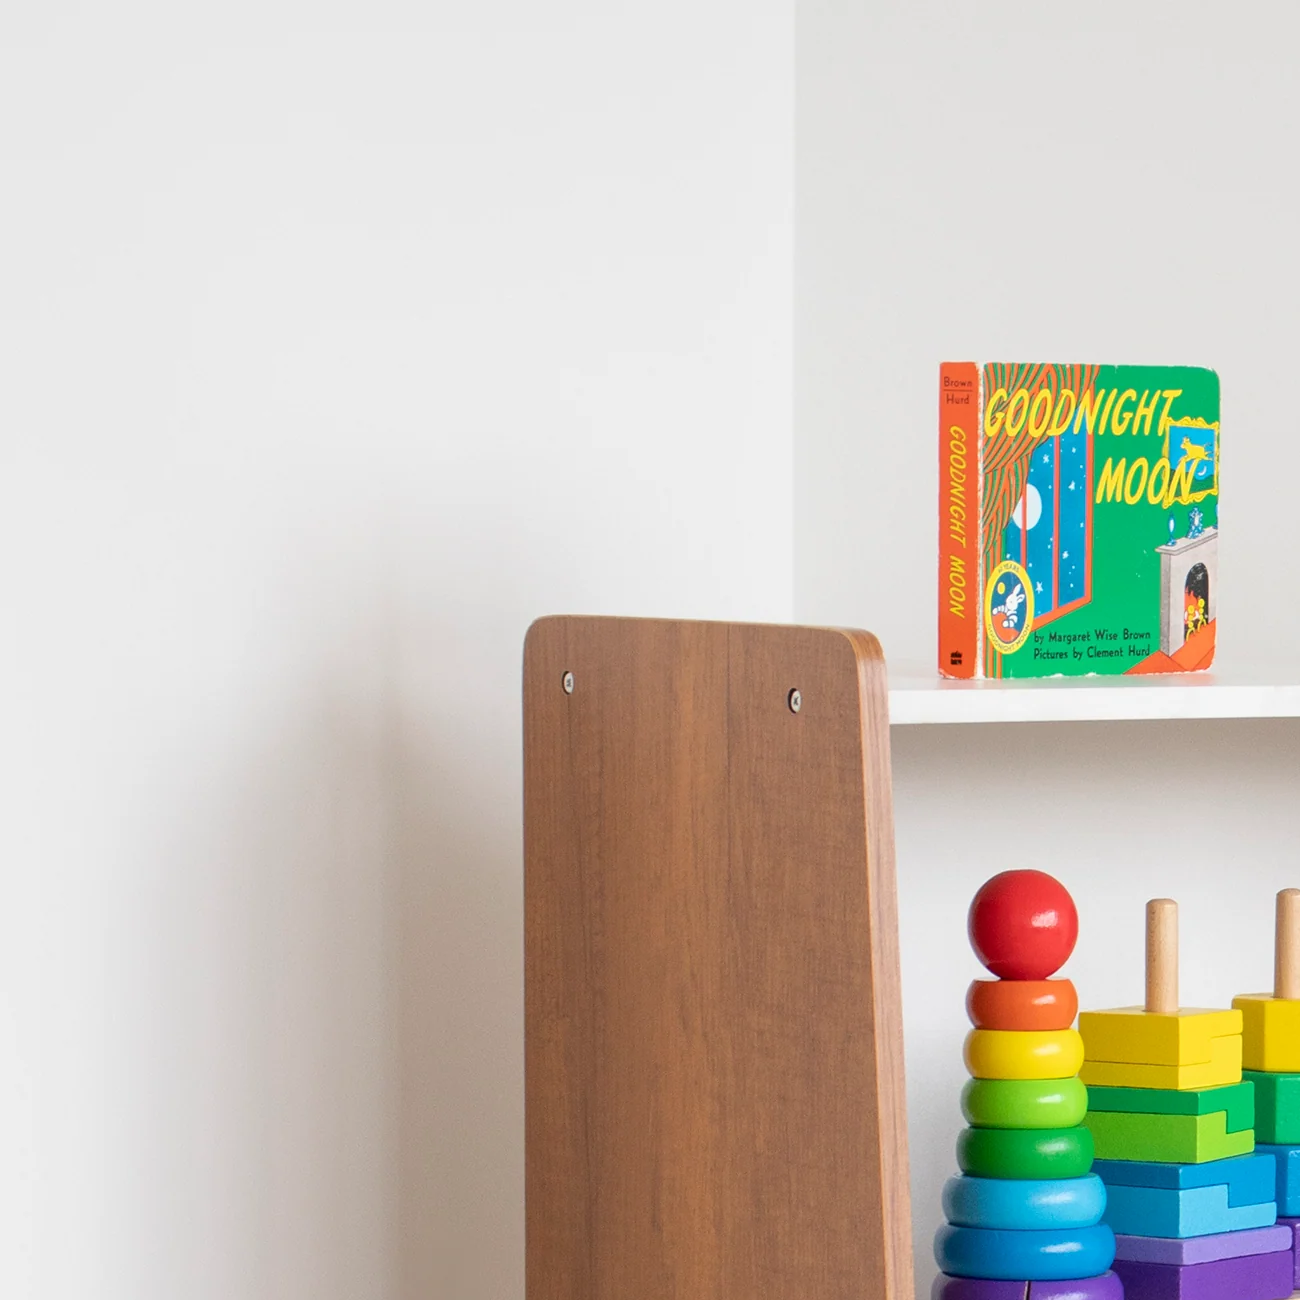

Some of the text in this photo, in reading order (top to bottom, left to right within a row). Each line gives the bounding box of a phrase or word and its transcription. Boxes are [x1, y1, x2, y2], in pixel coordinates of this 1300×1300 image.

[943, 377, 972, 388] Brown
[946, 393, 969, 405] Hurd
[984, 388, 1183, 437] GOODNIGHT
[1095, 457, 1198, 505] MOON
[949, 424, 966, 618] GOODNIGHT MOON
[1034, 628, 1151, 645] by Margaret Wise Brown
[1033, 644, 1151, 660] Pictures by Clement Hurd
